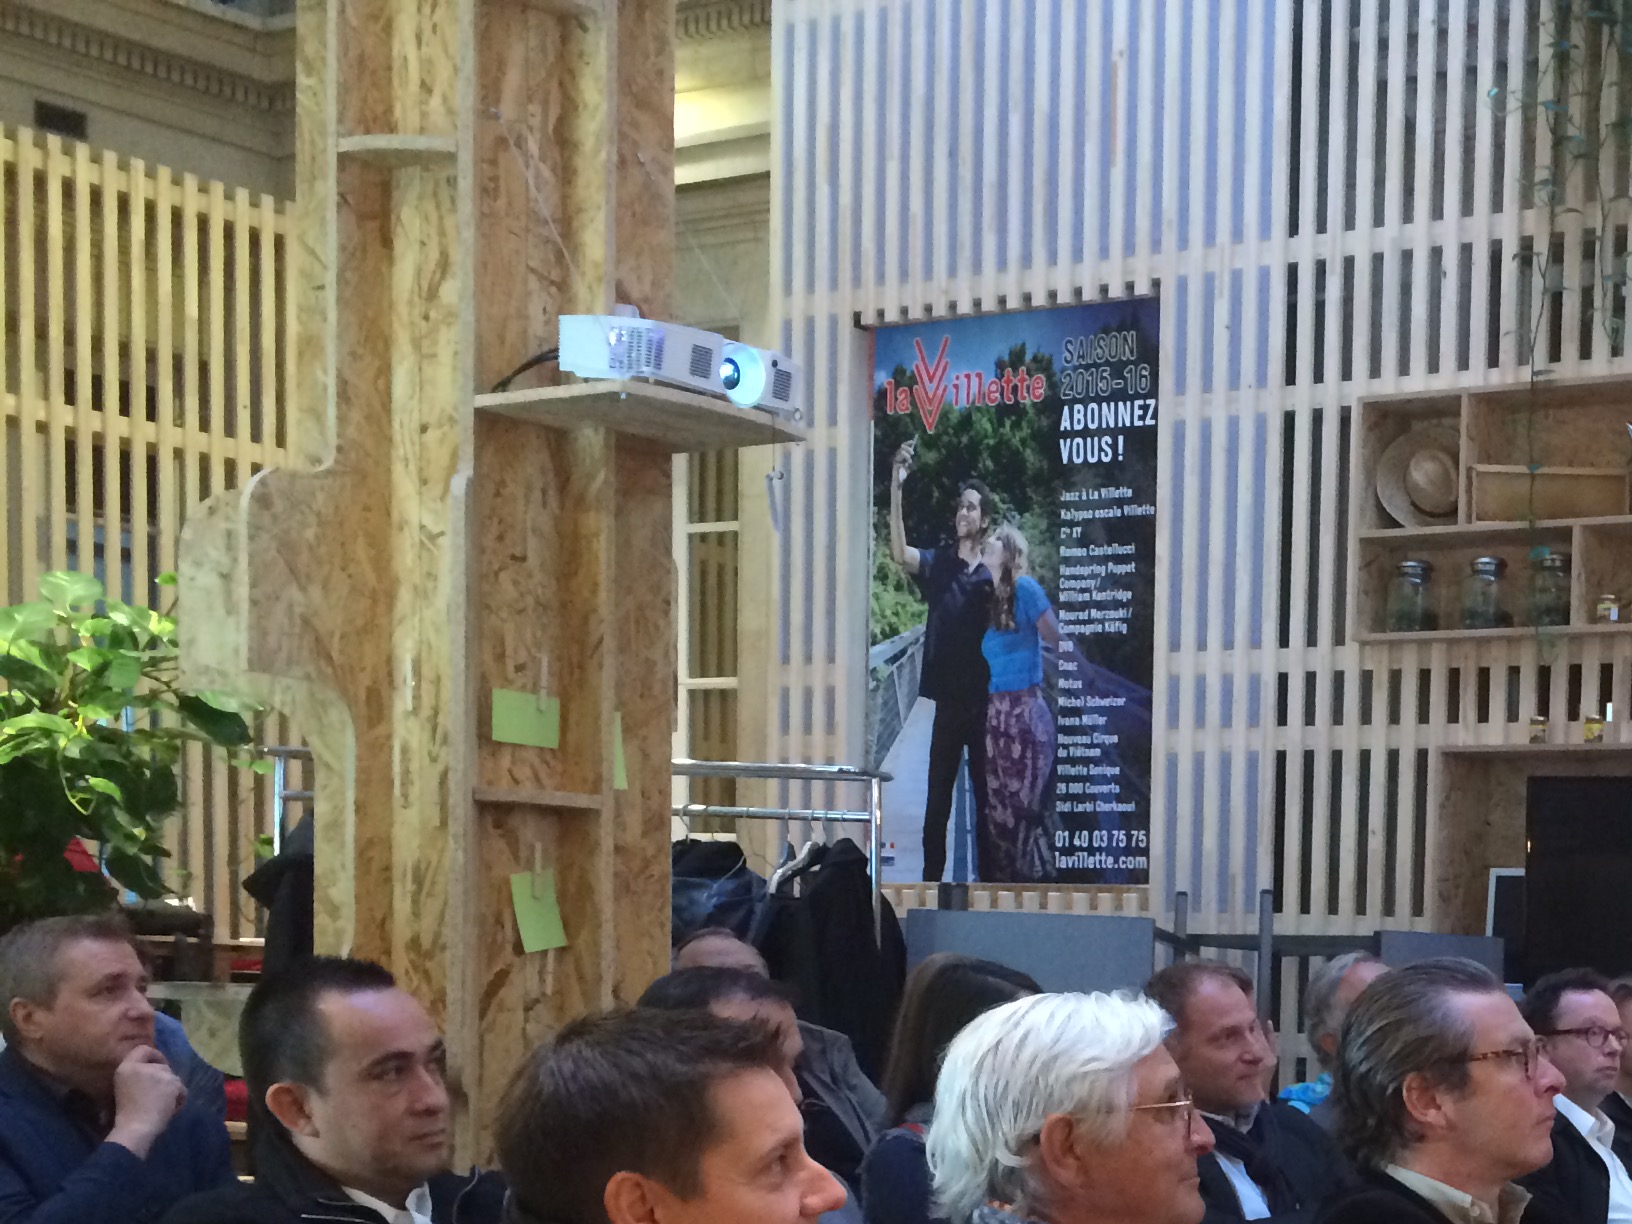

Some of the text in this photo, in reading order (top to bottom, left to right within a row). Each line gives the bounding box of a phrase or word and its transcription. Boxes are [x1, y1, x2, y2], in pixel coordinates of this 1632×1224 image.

[1063, 331, 1136, 366] SAISON
[885, 335, 1045, 434] la Villette
[1060, 364, 1150, 399] 2015-16
[1060, 399, 1156, 431] ABONNEZ
[1055, 831, 1146, 847] 01 40 03 75 75
[1054, 852, 1147, 869] lavillette.com
